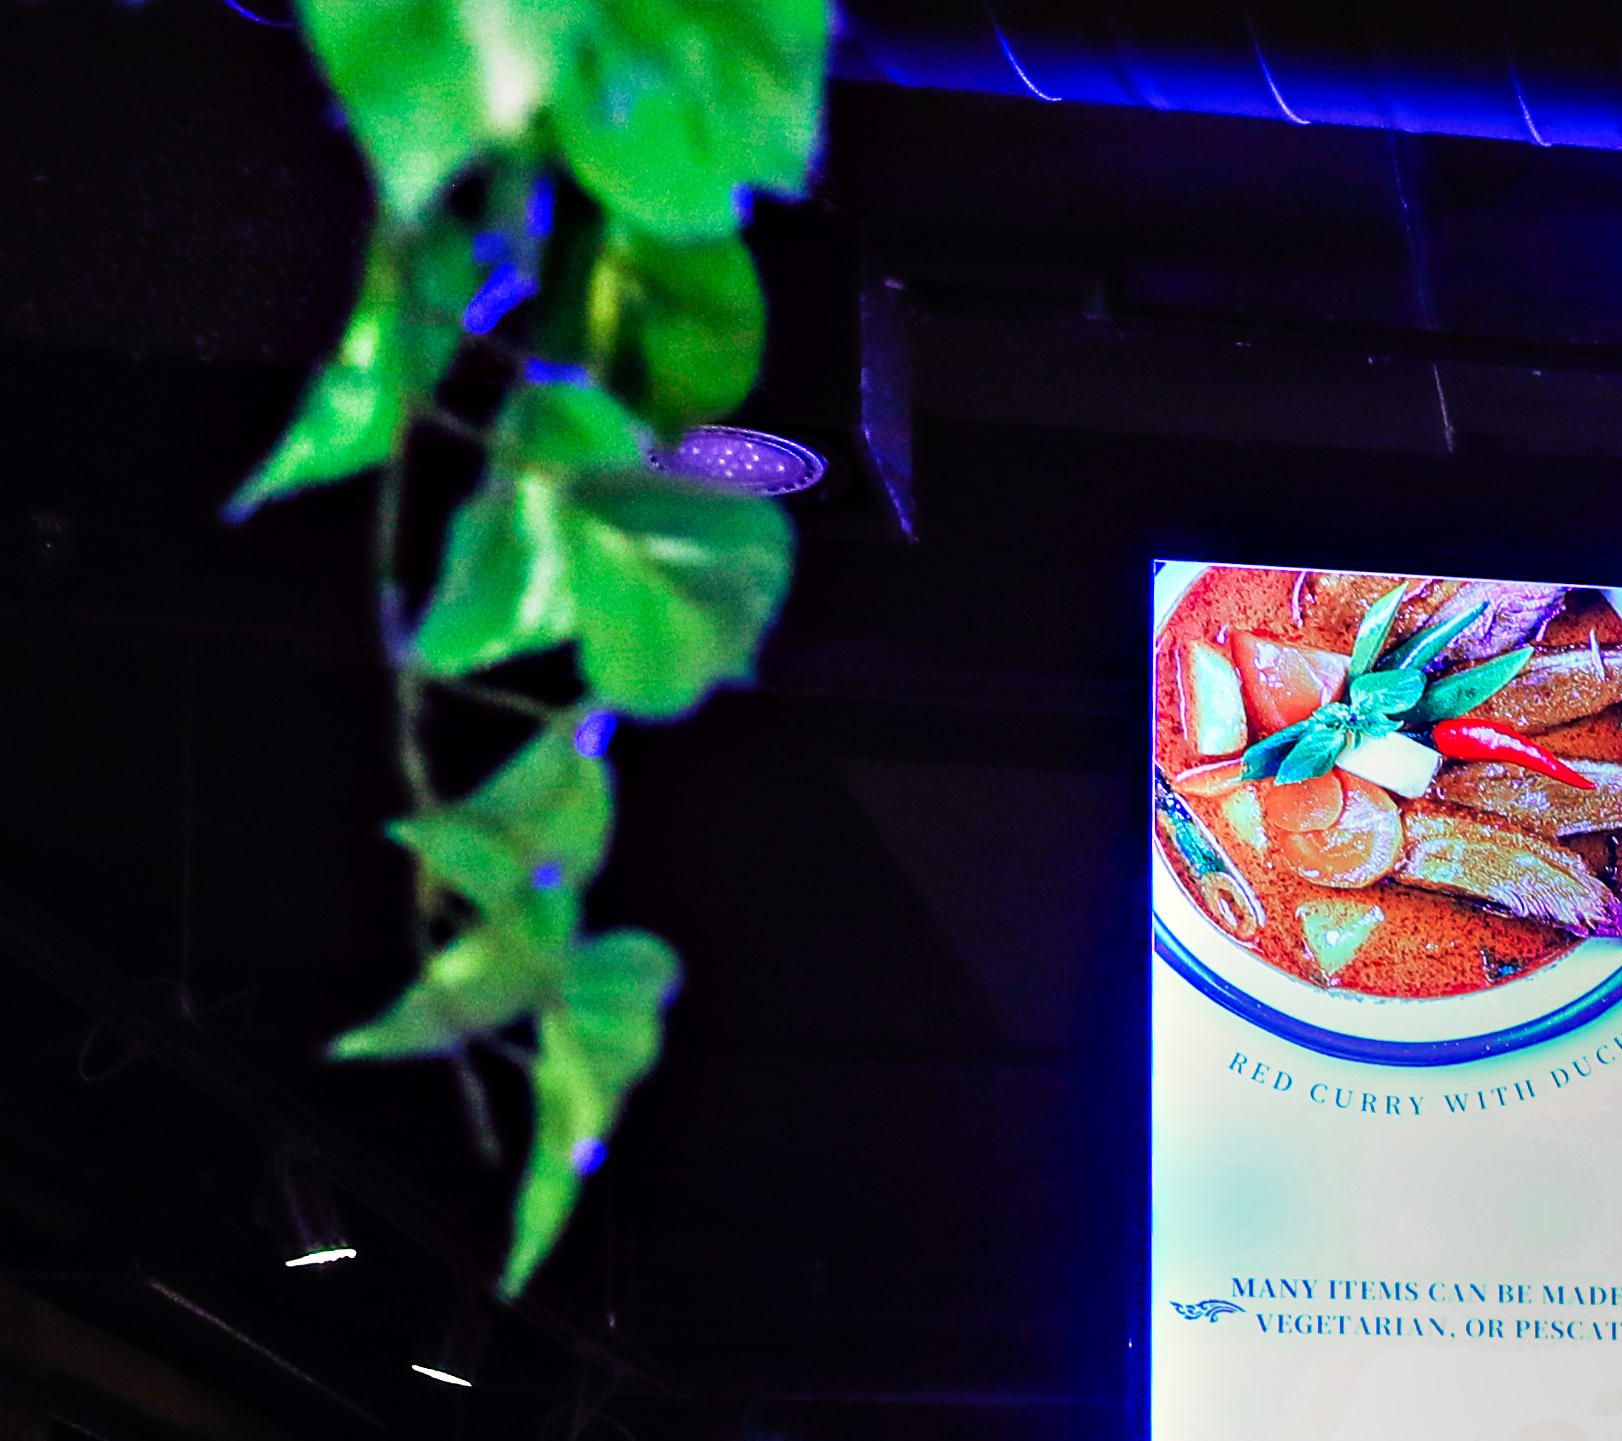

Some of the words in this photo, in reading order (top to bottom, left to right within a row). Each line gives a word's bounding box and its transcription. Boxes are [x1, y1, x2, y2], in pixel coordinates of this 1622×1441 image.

[1229, 1052, 1294, 1092] RED
[1309, 1083, 1424, 1116] CURRY
[1444, 1079, 1536, 1114] WITH
